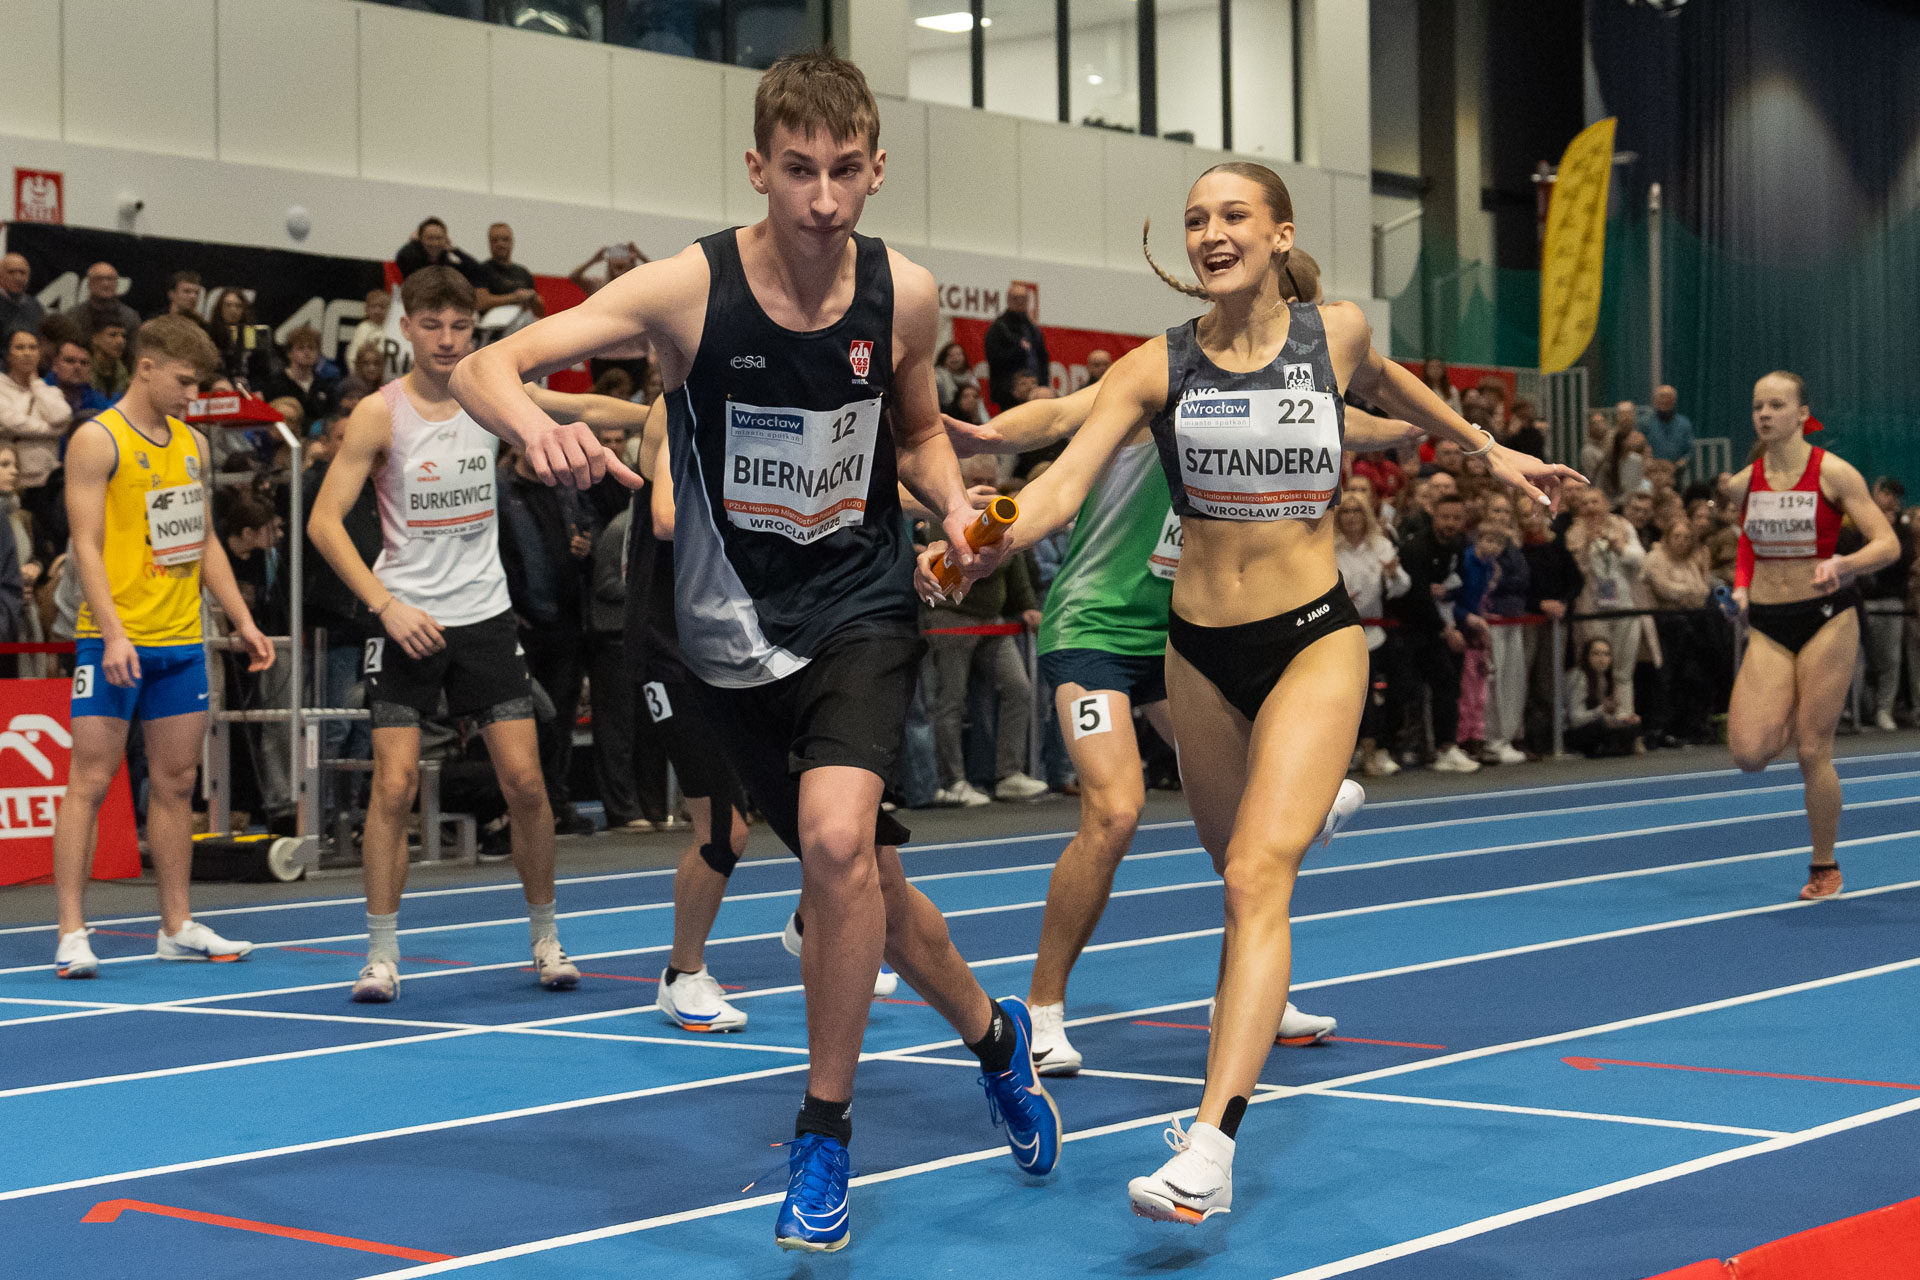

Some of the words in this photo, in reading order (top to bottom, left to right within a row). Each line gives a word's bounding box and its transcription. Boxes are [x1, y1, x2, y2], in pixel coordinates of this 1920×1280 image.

[1184, 401, 1247, 415] Wrocław
[1277, 398, 1316, 424] 22
[735, 412, 801, 431] Wrocław
[831, 411, 858, 444] 12
[735, 429, 764, 438] miasto
[457, 455, 487, 474] 740
[1185, 447, 1334, 477] SZTANDERA
[733, 454, 864, 498] BIERNACKI
[151, 491, 176, 510] 4F
[410, 483, 492, 510] BURKIEWICZ
[729, 502, 747, 511] PZLA
[749, 503, 779, 514] Halowe
[847, 501, 863, 509] U20
[1203, 492, 1231, 501] Halowe
[1303, 492, 1317, 500] U18
[1779, 495, 1814, 509] 1194
[1205, 504, 1280, 518] WROCŁAW
[1282, 505, 1317, 516] 2025
[749, 518, 818, 541] WROCŁAW
[817, 515, 841, 535] 2025
[1306, 603, 1330, 623] JAKO
[366, 640, 378, 669] 2
[75, 668, 87, 695] 6
[646, 686, 664, 718] 3
[1079, 698, 1101, 732] 5
